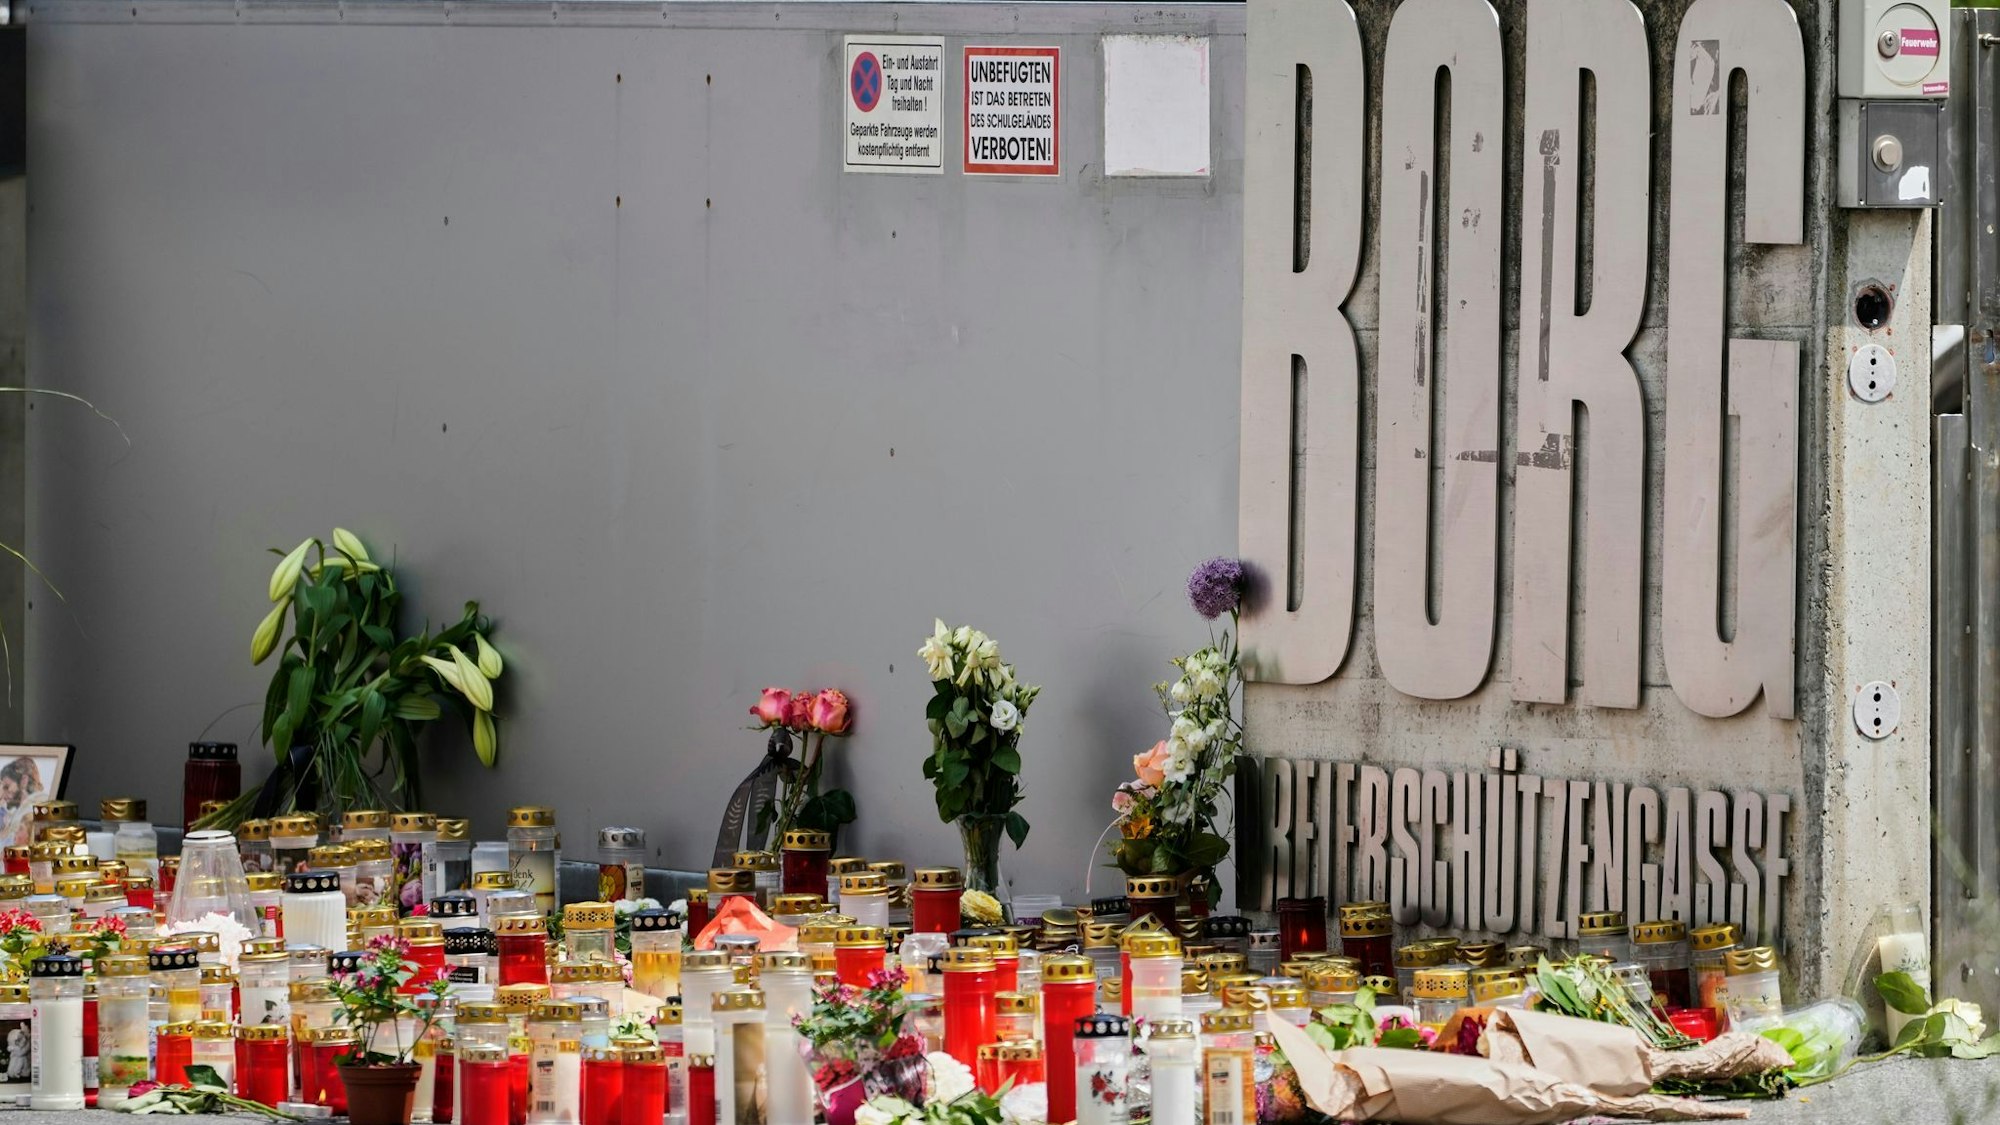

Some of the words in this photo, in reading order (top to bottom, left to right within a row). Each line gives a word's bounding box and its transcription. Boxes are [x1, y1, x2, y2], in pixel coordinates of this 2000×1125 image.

[1901, 36, 1938, 48] Feuerwehr
[882, 54, 895, 69] Ein-
[897, 55, 908, 70] und
[910, 55, 938, 70] Ausfahrt
[971, 61, 1051, 83] UNBEFUGTEN
[887, 75, 898, 93] Tag
[900, 75, 912, 91] und
[914, 76, 933, 91] Nacht
[892, 95, 922, 112] freihalten
[971, 91, 984, 106] IST
[987, 91, 1005, 106] DAS
[1008, 92, 1051, 107] BETRETEN
[970, 113, 985, 128] DES
[987, 111, 1051, 129] SCHULGELÄNDES
[850, 122, 879, 139] Geparkte
[880, 123, 913, 141] Fahrzeuge
[914, 124, 938, 138] werden
[857, 141, 904, 160] kostenpflichtig
[905, 143, 930, 157] entfernt
[971, 136, 1051, 161] VERBOTEN!
[1239, 0, 1805, 719] BORG
